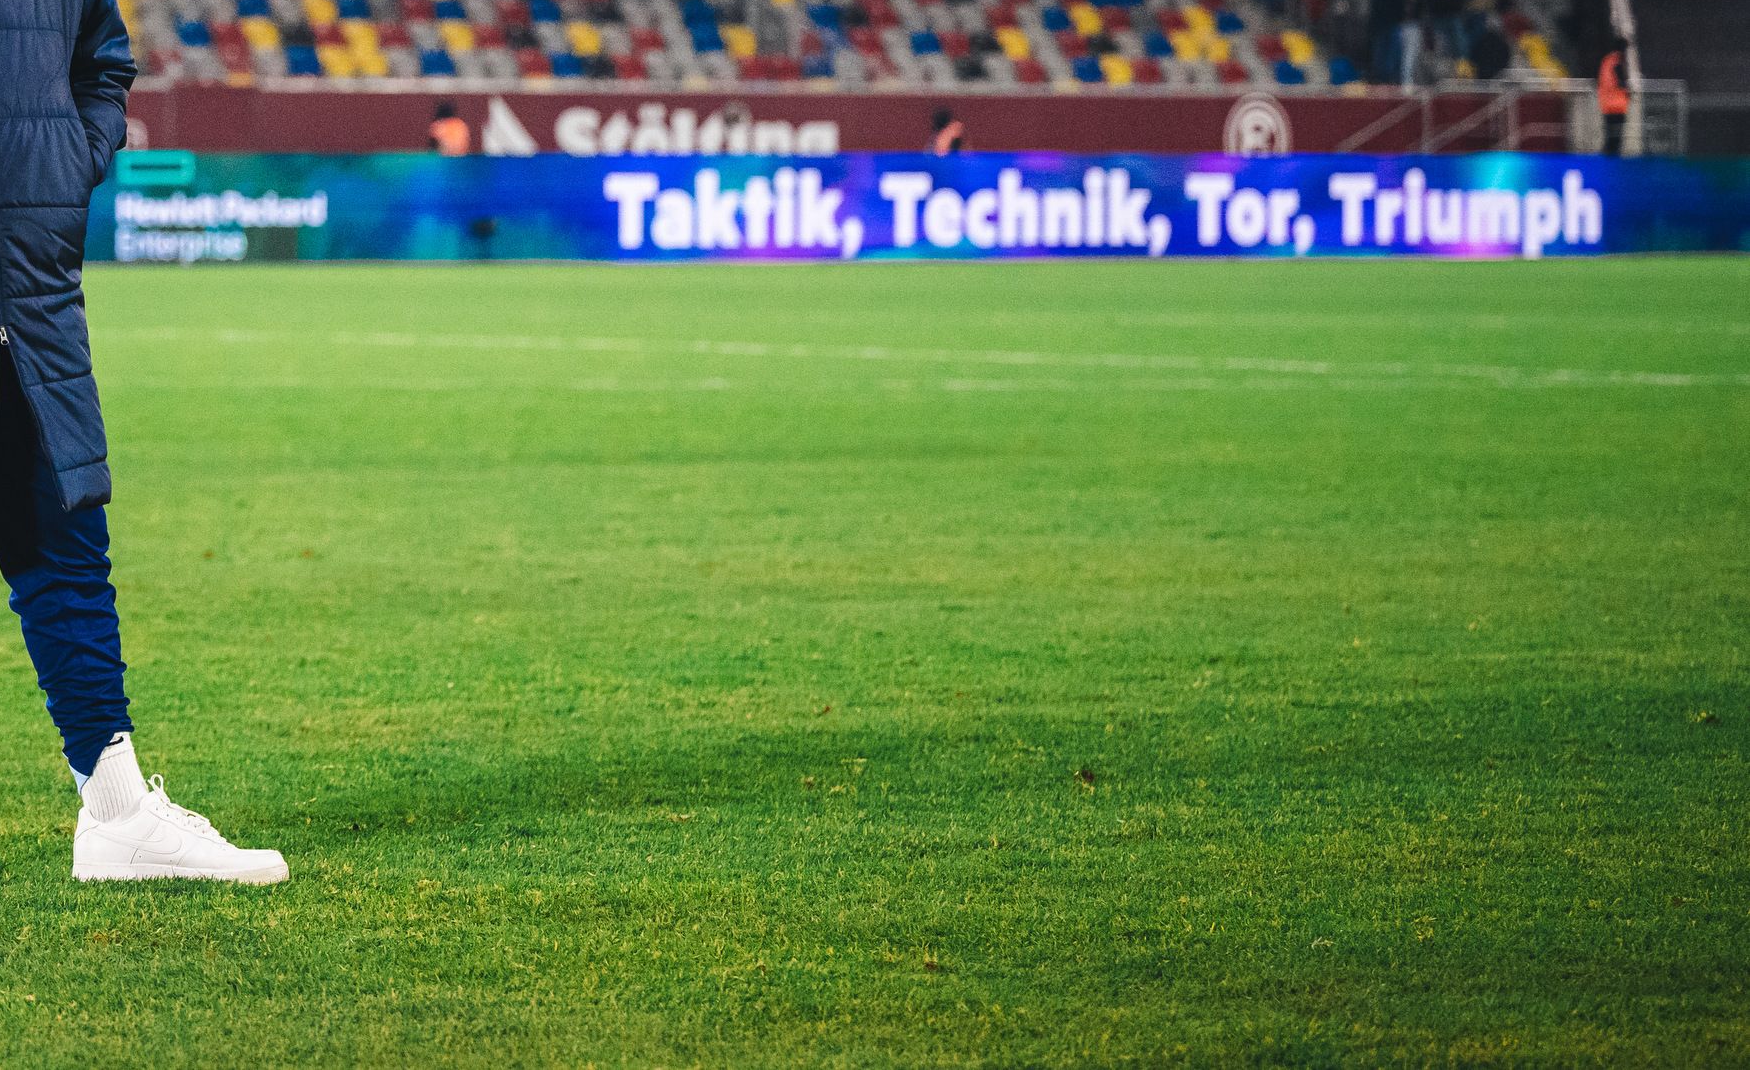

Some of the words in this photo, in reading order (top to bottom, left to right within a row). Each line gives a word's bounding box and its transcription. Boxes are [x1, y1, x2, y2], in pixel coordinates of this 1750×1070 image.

[602, 166, 864, 259] Taktik,
[878, 166, 1173, 259] Technik,
[1184, 171, 1316, 256] Tor,
[1328, 166, 1604, 260] Triumph
